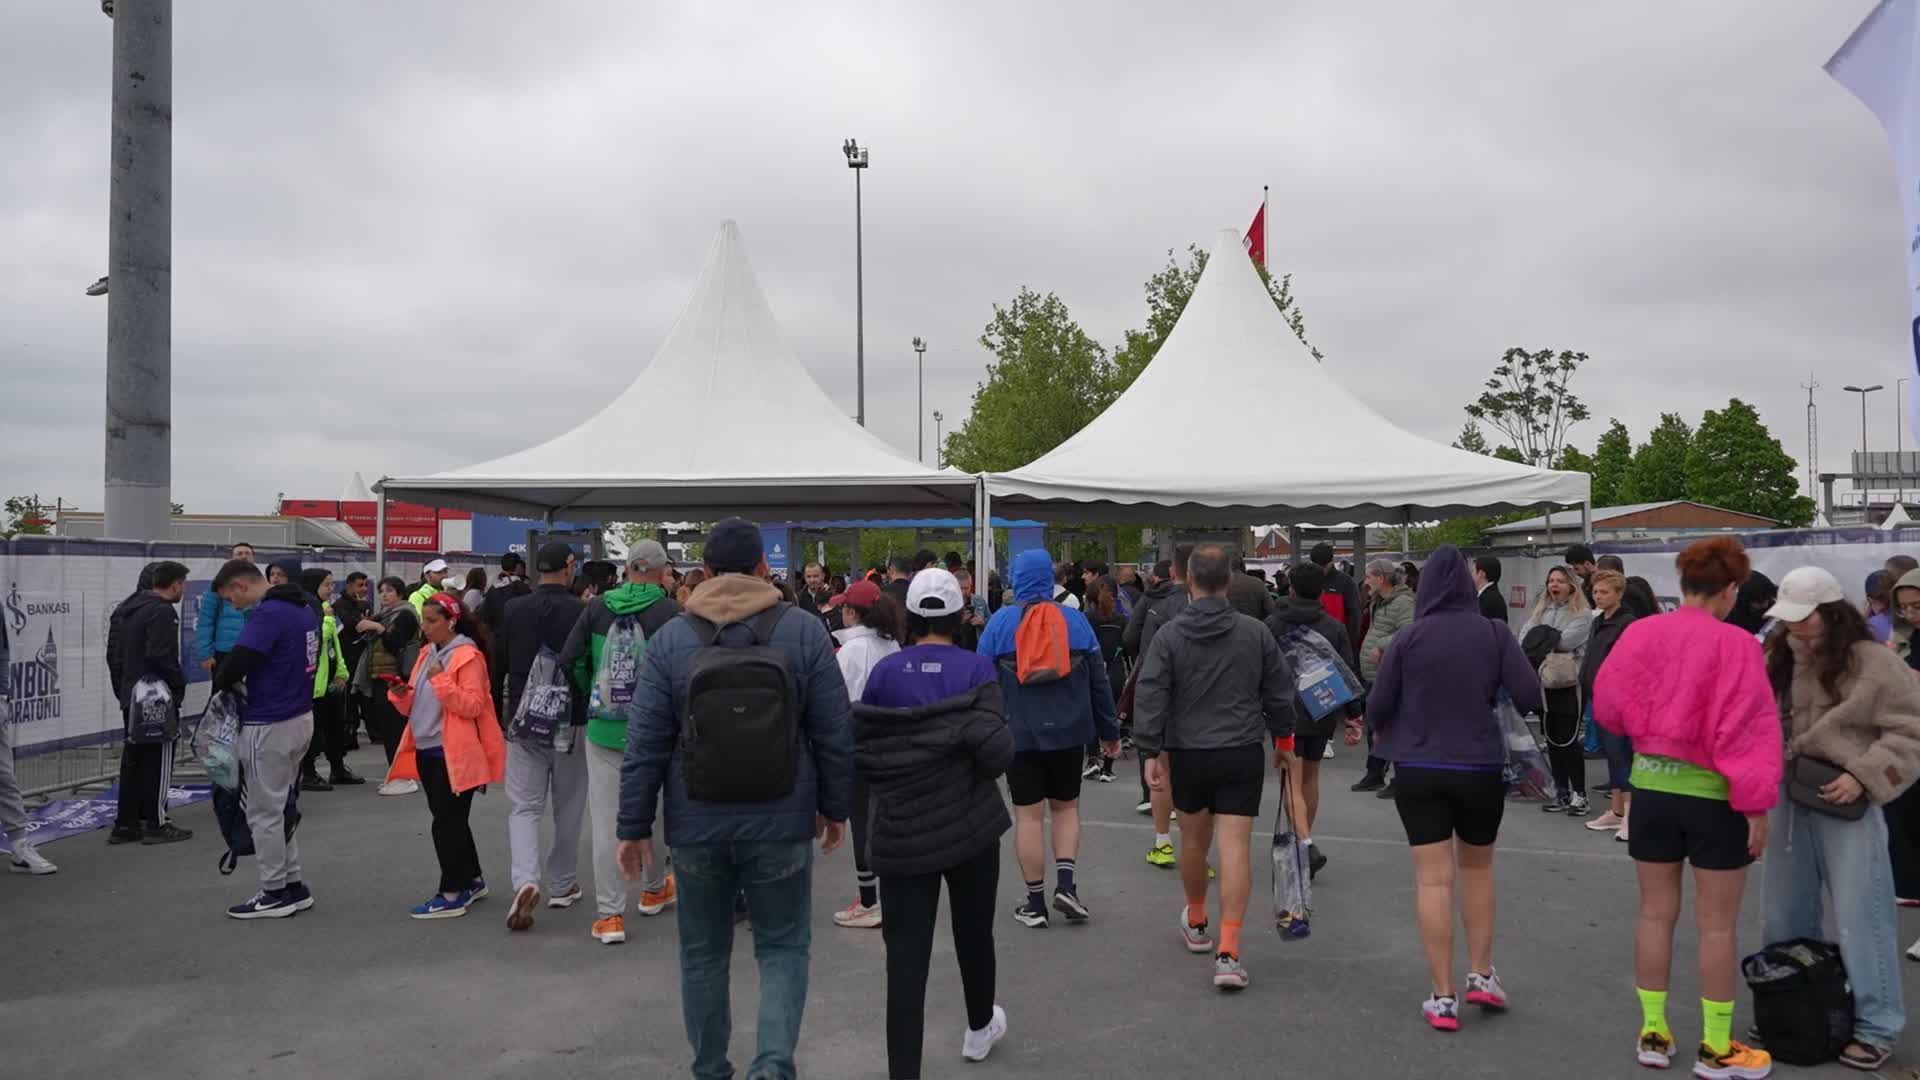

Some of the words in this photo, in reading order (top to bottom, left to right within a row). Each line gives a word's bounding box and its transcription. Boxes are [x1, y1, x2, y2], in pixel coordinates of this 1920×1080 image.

[27, 602, 70, 615] BANKASI
[9, 661, 60, 701] NBUL
[8, 695, 61, 724] ARATONU
